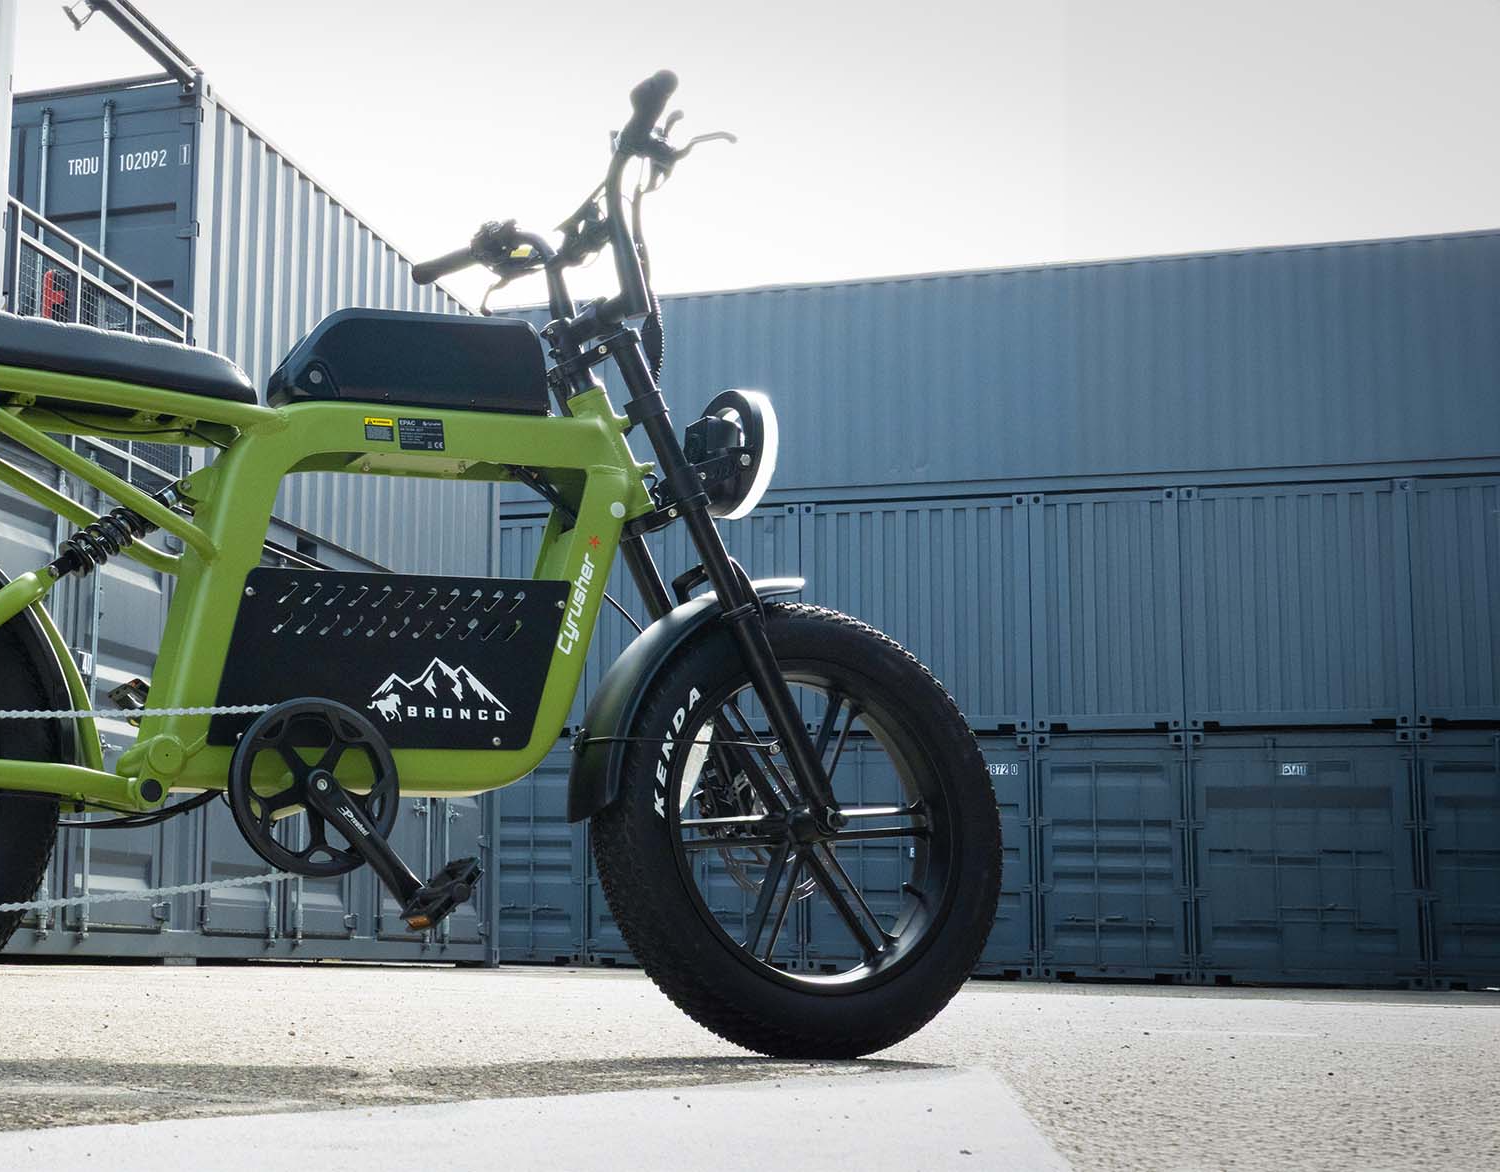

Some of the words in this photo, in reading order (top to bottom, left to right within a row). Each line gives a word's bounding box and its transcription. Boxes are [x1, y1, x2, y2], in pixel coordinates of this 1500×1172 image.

[68, 156, 99, 176] TRDU
[119, 149, 167, 172] 102092
[556, 552, 596, 656] Cyrusher
[407, 705, 506, 722] BRONCO
[654, 687, 701, 819] KENDA
